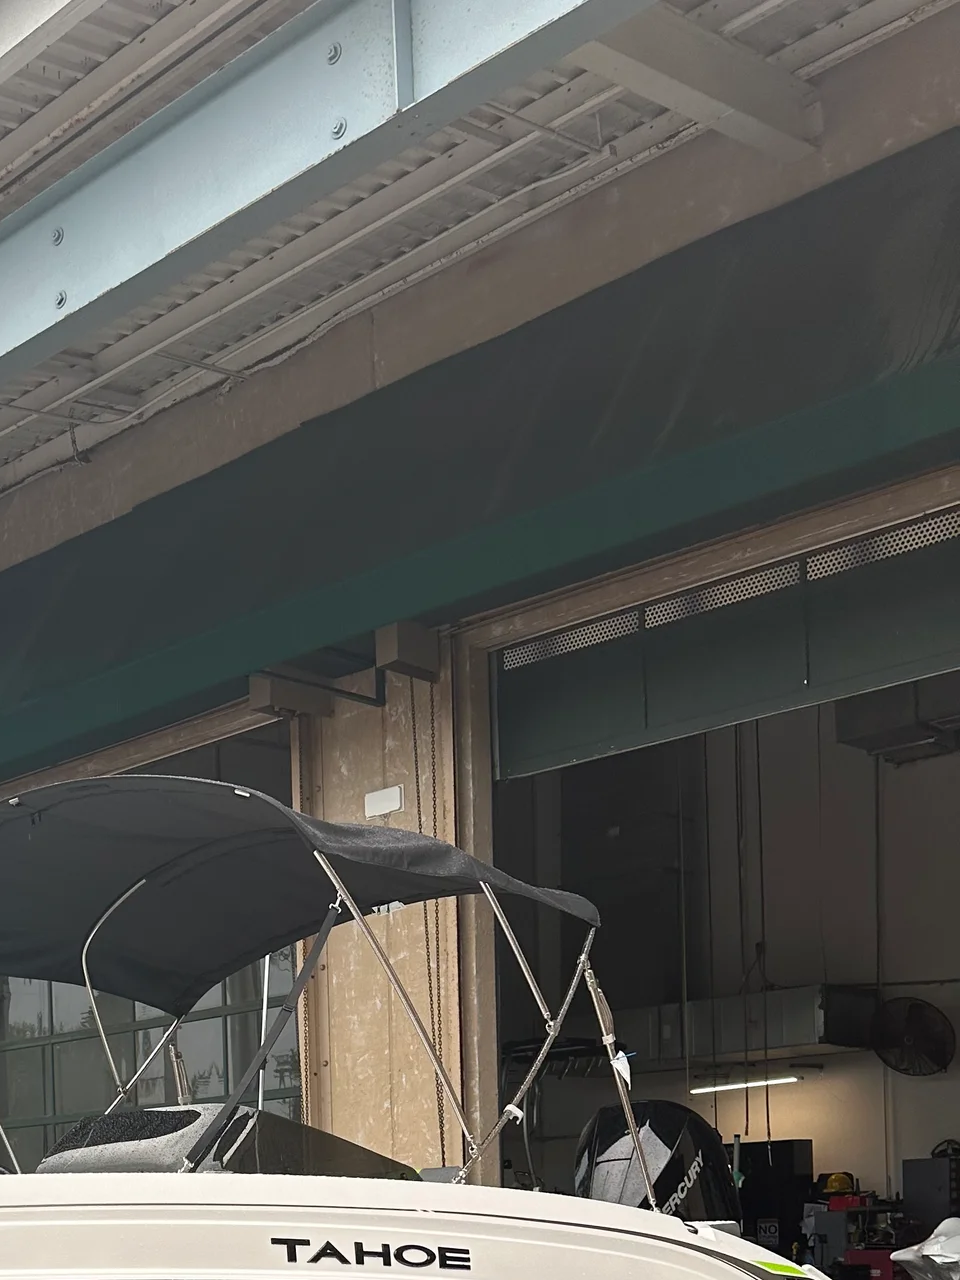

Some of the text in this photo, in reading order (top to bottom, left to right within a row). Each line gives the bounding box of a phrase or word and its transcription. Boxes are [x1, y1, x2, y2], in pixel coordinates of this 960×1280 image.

[658, 1149, 704, 1215] ERCURY
[759, 1224, 778, 1235] NO
[270, 1237, 471, 1270] TAHOE
